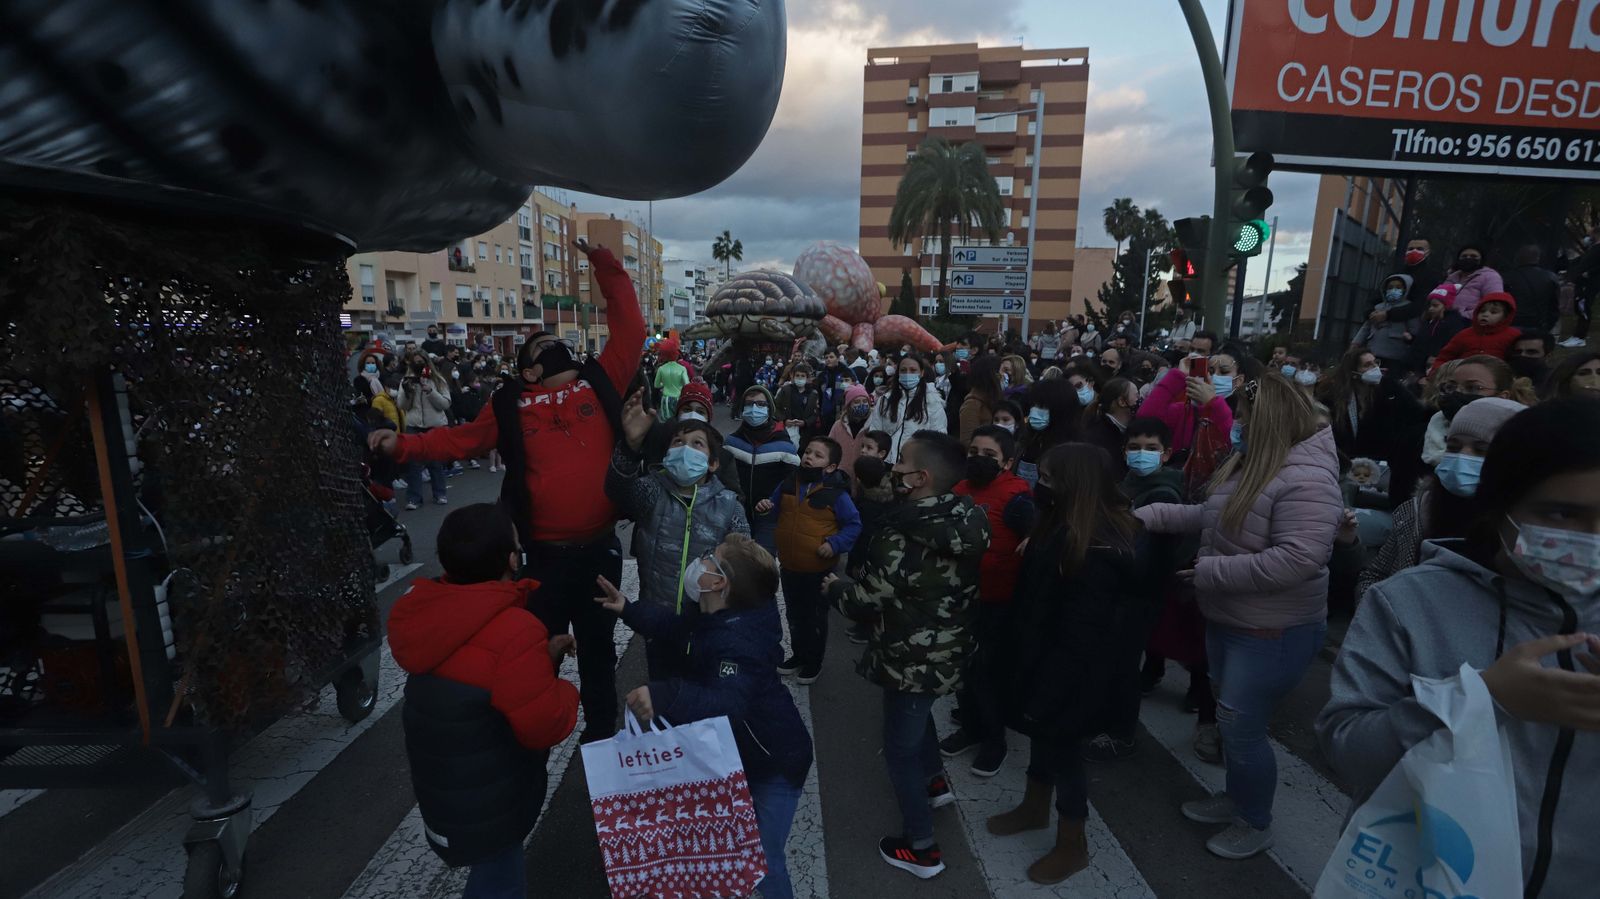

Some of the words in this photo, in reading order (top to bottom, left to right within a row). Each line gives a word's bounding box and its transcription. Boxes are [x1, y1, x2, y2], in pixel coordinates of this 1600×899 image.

[1277, 61, 1483, 113] CASEROS
[1495, 76, 1600, 119] DESD
[1392, 128, 1462, 156] Tlfno:
[1467, 132, 1512, 158] 956
[1516, 136, 1561, 161] 650
[618, 746, 684, 768] lefties
[1351, 832, 1398, 874] EL
